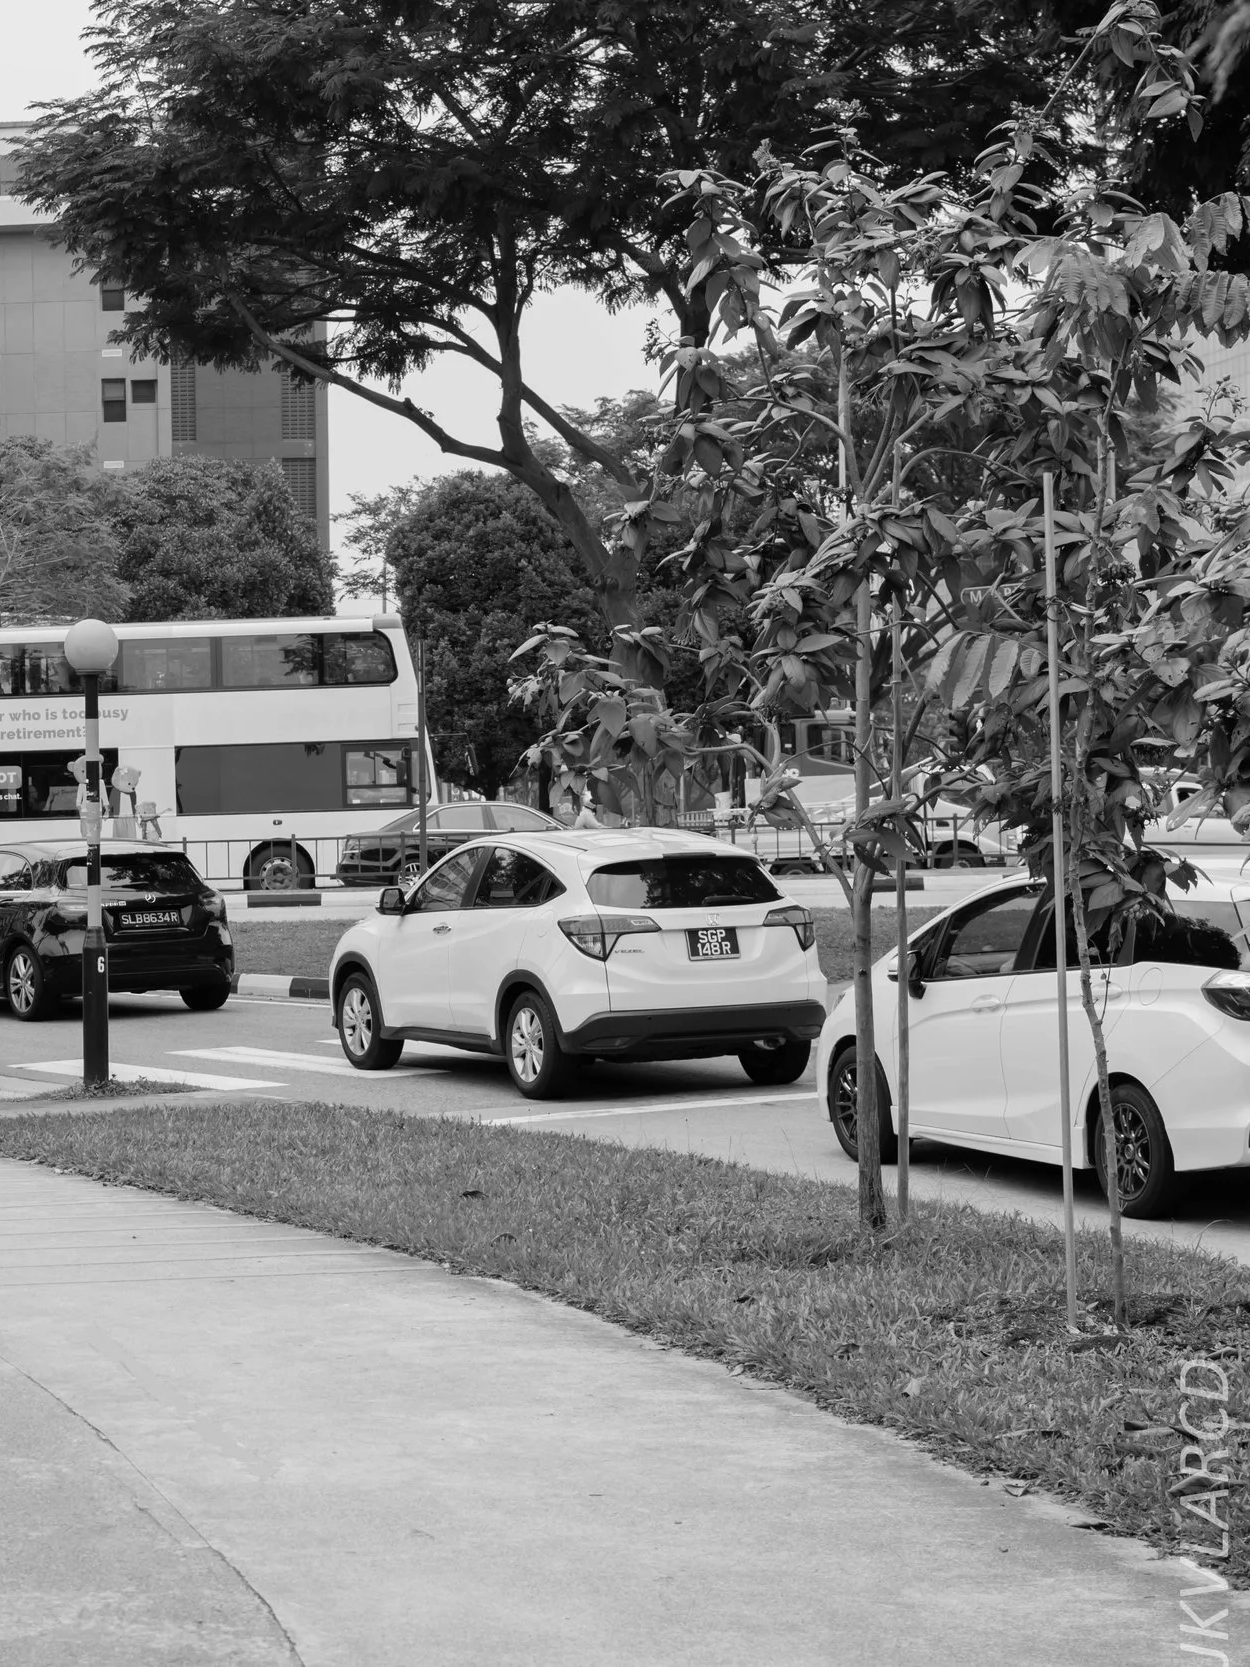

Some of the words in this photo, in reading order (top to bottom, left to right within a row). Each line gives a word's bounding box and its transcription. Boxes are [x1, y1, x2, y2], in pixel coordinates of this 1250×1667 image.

[8, 710, 41, 722] who
[46, 708, 58, 720] is
[98, 708, 129, 722] usy
[122, 912, 178, 924] SLB8634R
[698, 930, 726, 943] SGP
[98, 956, 105, 973] 6
